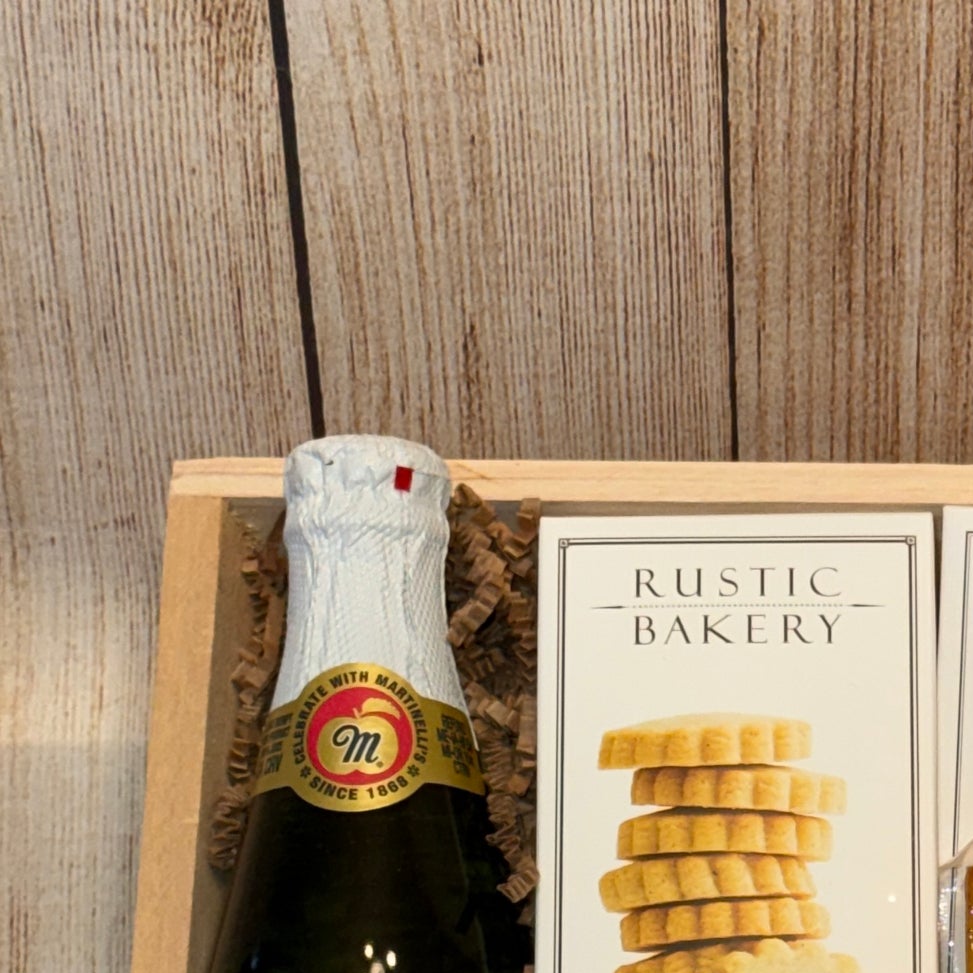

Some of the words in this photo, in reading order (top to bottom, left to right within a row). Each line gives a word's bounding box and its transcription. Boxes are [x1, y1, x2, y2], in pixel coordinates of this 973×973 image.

[635, 567, 842, 598] RUSTIC
[634, 614, 842, 645] BAKERY
[293, 685, 328, 765] CELEBRATE
[329, 671, 369, 689] WITH
[375, 674, 429, 764] MARTINELLI'S
[309, 776, 358, 801] SINCE
[366, 775, 409, 799] 1868
